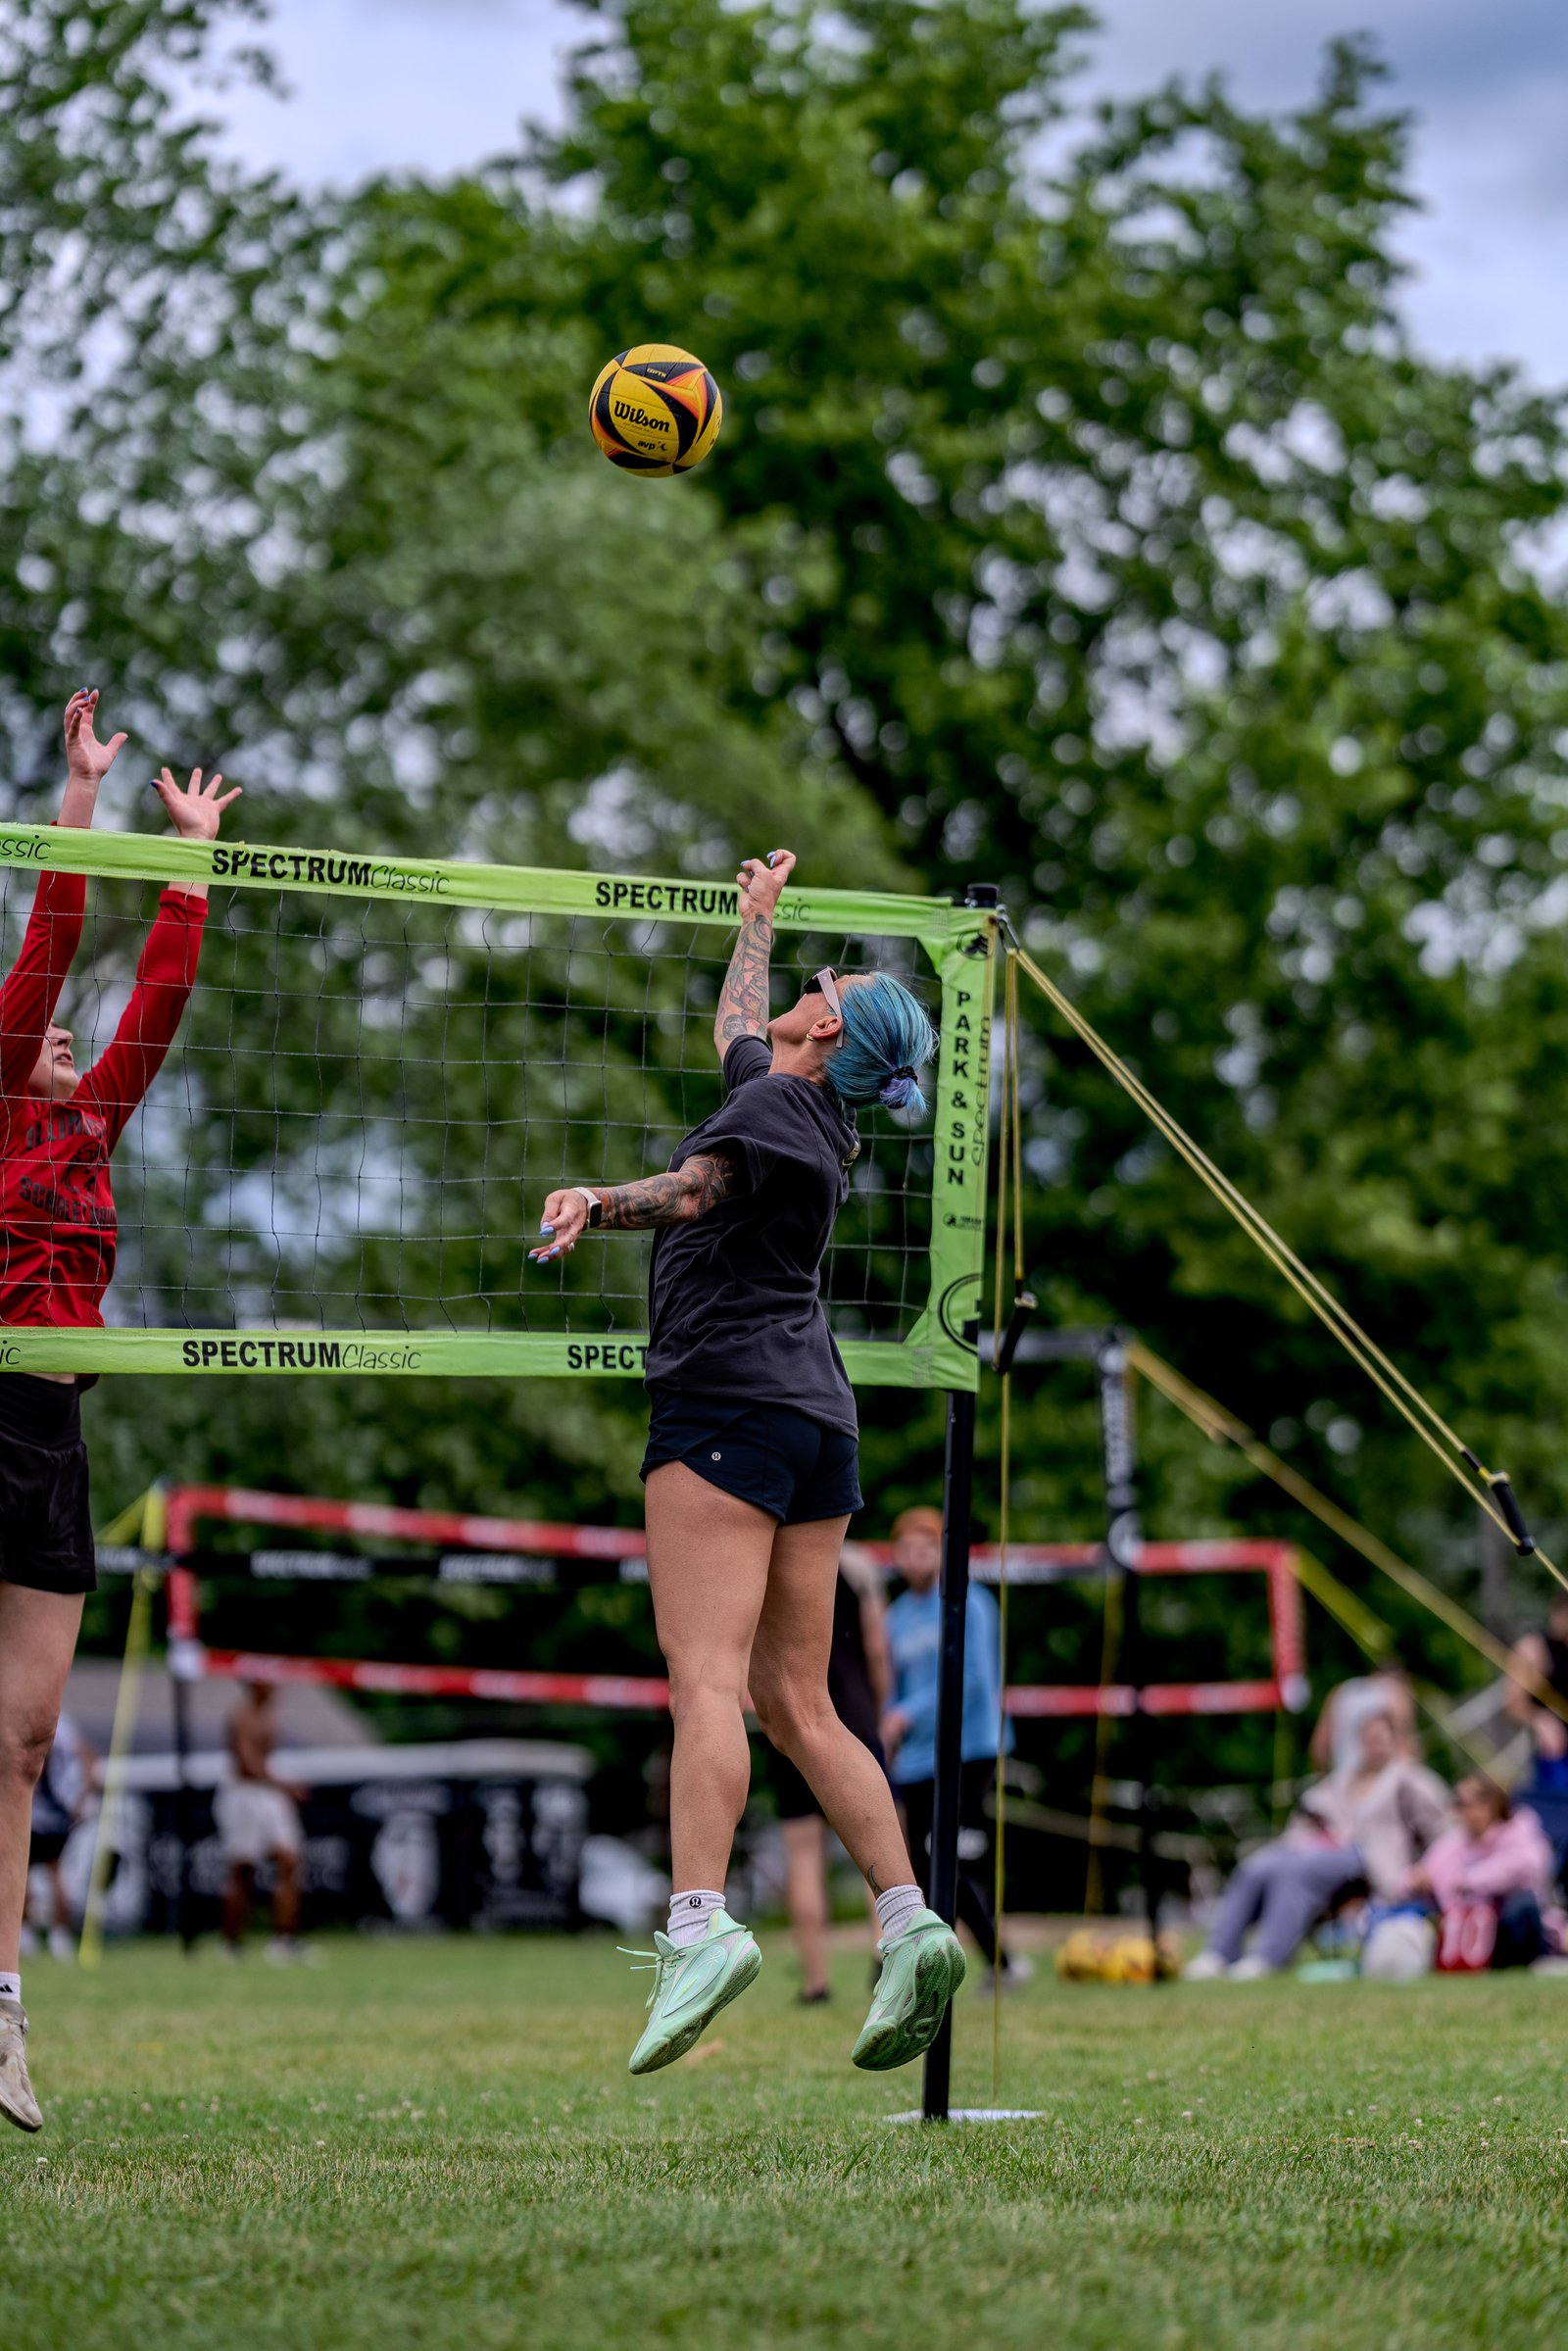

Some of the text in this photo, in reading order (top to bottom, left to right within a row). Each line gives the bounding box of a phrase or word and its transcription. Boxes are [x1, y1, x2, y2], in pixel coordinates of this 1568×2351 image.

[613, 400, 670, 433] Wilson
[637, 440, 656, 451] avp
[0, 834, 51, 860] ssic
[595, 881, 738, 915] SPECTRUM
[947, 991, 971, 1186] PARK & SUN
[567, 1345, 648, 1370] SPECT
